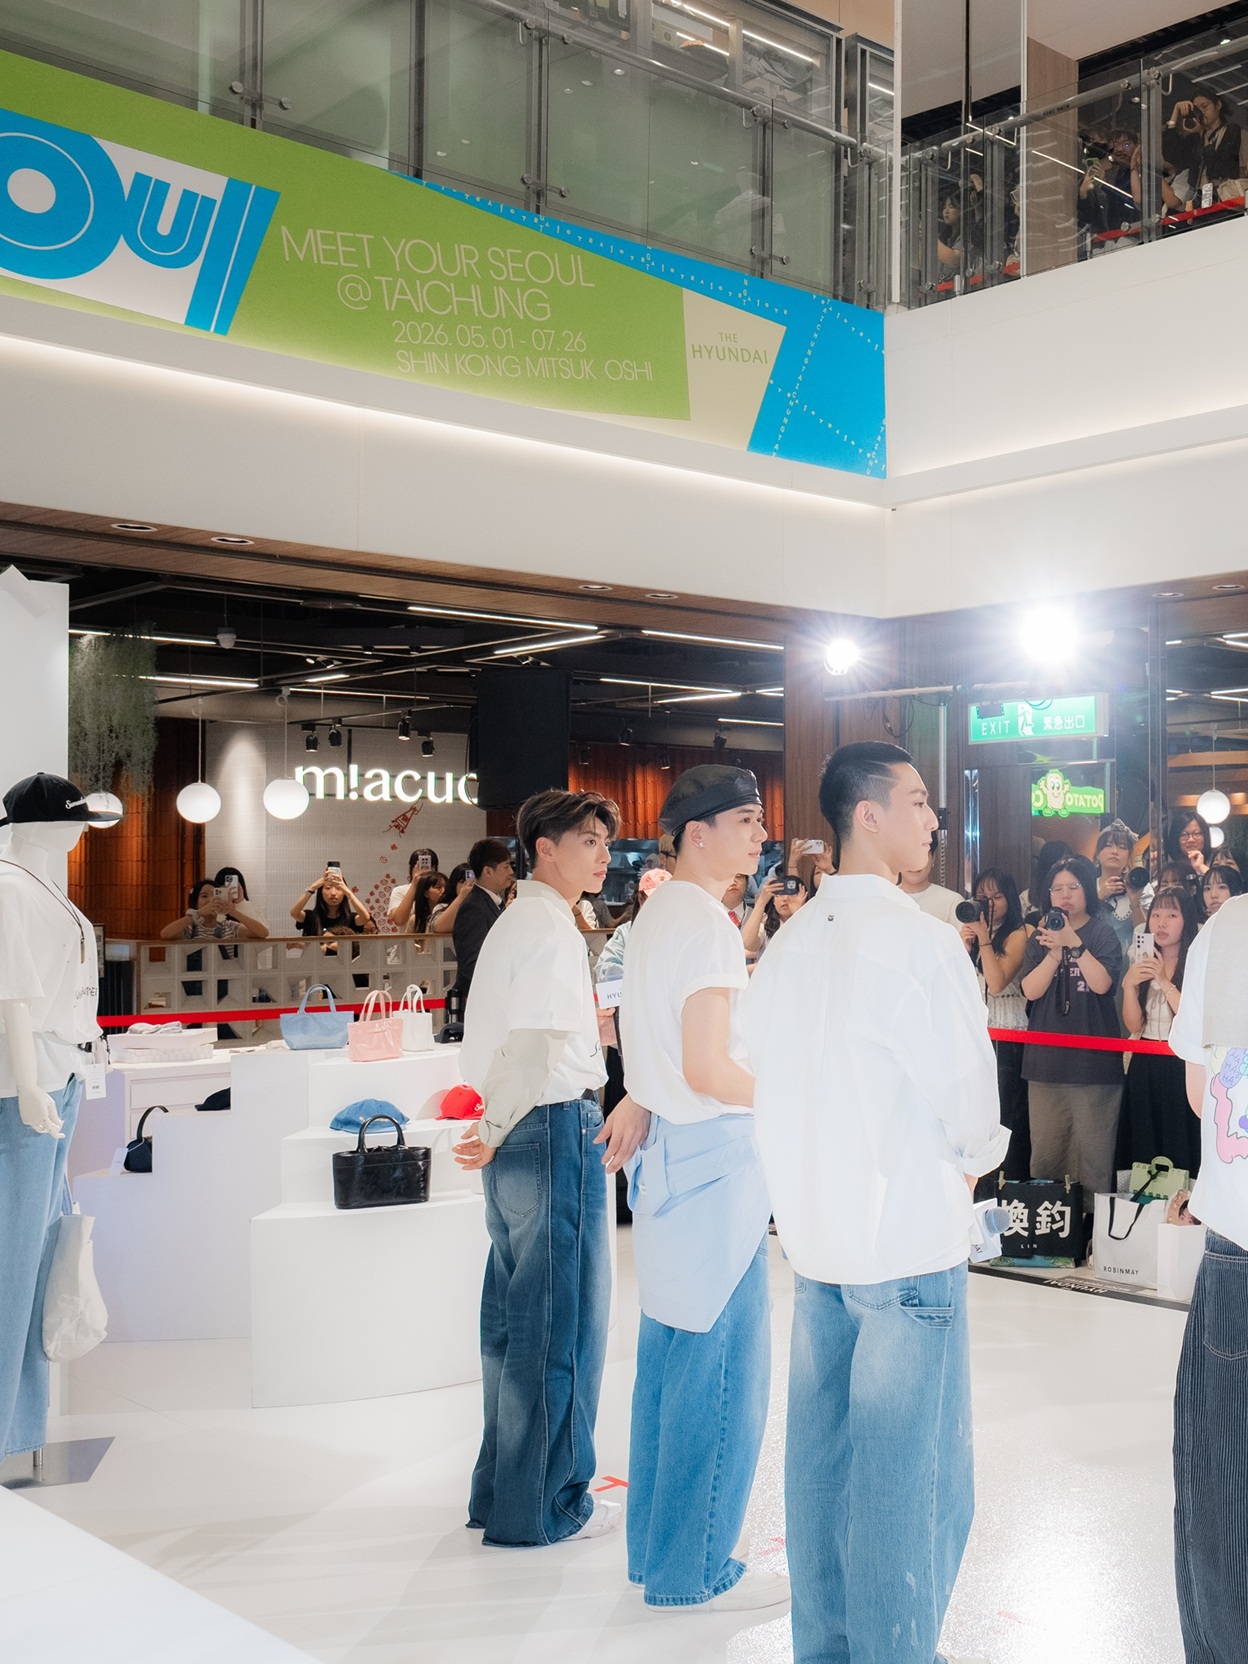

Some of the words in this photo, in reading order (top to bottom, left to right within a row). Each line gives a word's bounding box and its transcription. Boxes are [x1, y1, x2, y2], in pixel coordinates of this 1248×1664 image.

[281, 226, 373, 268] MEET
[382, 236, 481, 278] YOUR
[488, 247, 595, 287] SEOUL
[719, 332, 738, 343] THE
[691, 344, 768, 365] HYUNDAI
[396, 350, 449, 375] SHIN
[456, 353, 521, 378] KONG
[605, 359, 653, 382] OSHI
[981, 720, 1010, 736] EXIT
[1043, 715, 1085, 731] 緊急出口
[1103, 1265, 1140, 1276] ROBINMAY
